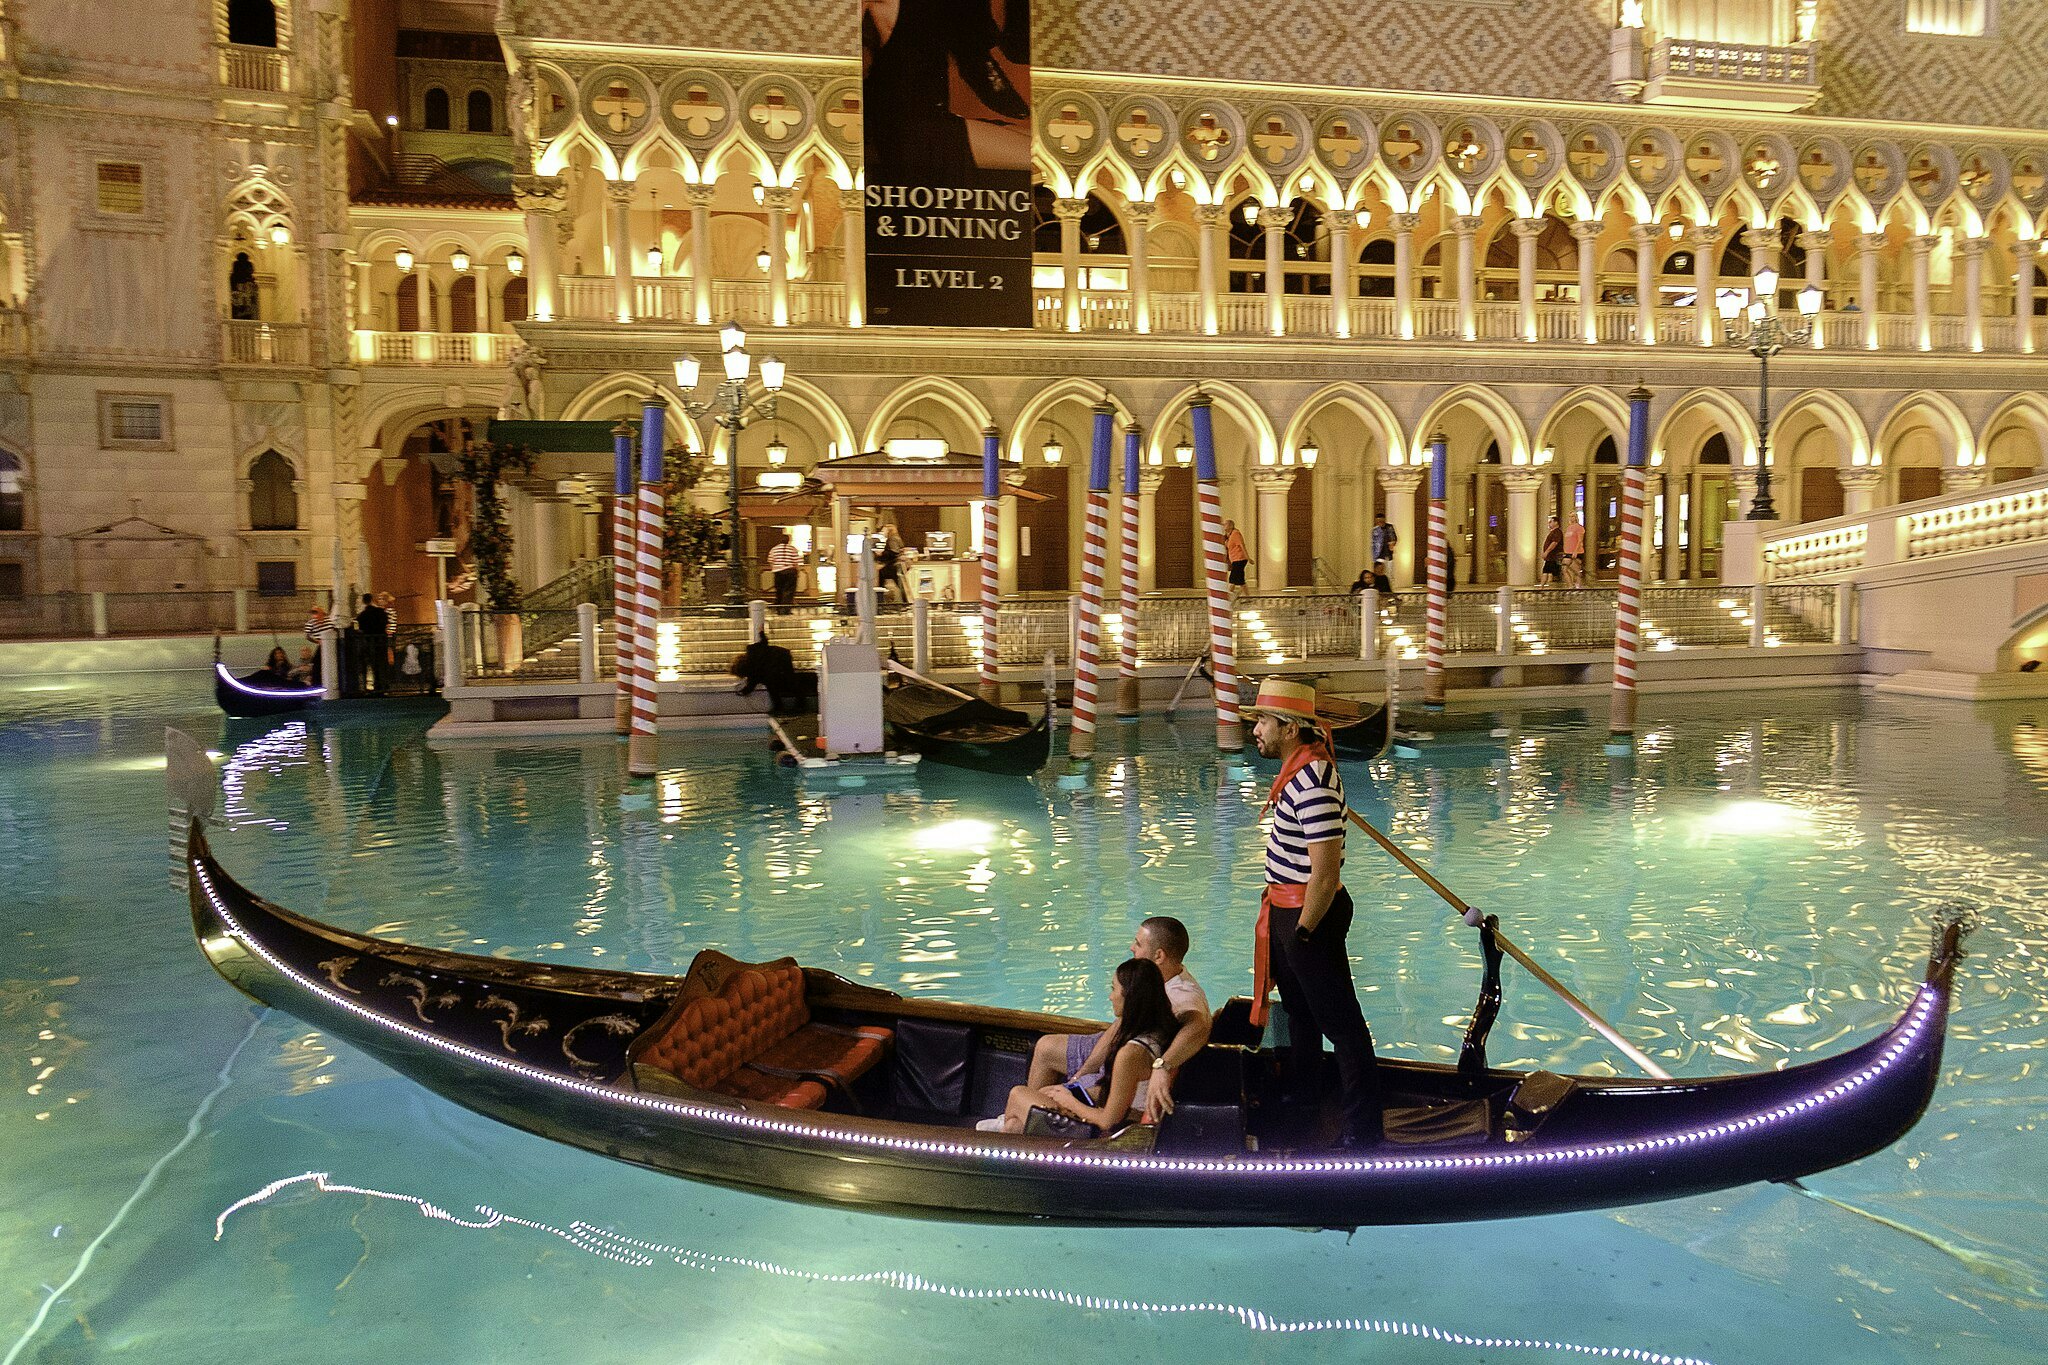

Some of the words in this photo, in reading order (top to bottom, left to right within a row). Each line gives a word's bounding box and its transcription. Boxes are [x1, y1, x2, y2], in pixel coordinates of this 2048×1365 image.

[865, 185, 1032, 213] SHOPPING
[876, 215, 898, 237] &
[903, 215, 1022, 241] DINING
[895, 268, 984, 290] LEVEL
[989, 275, 1004, 292] 2
